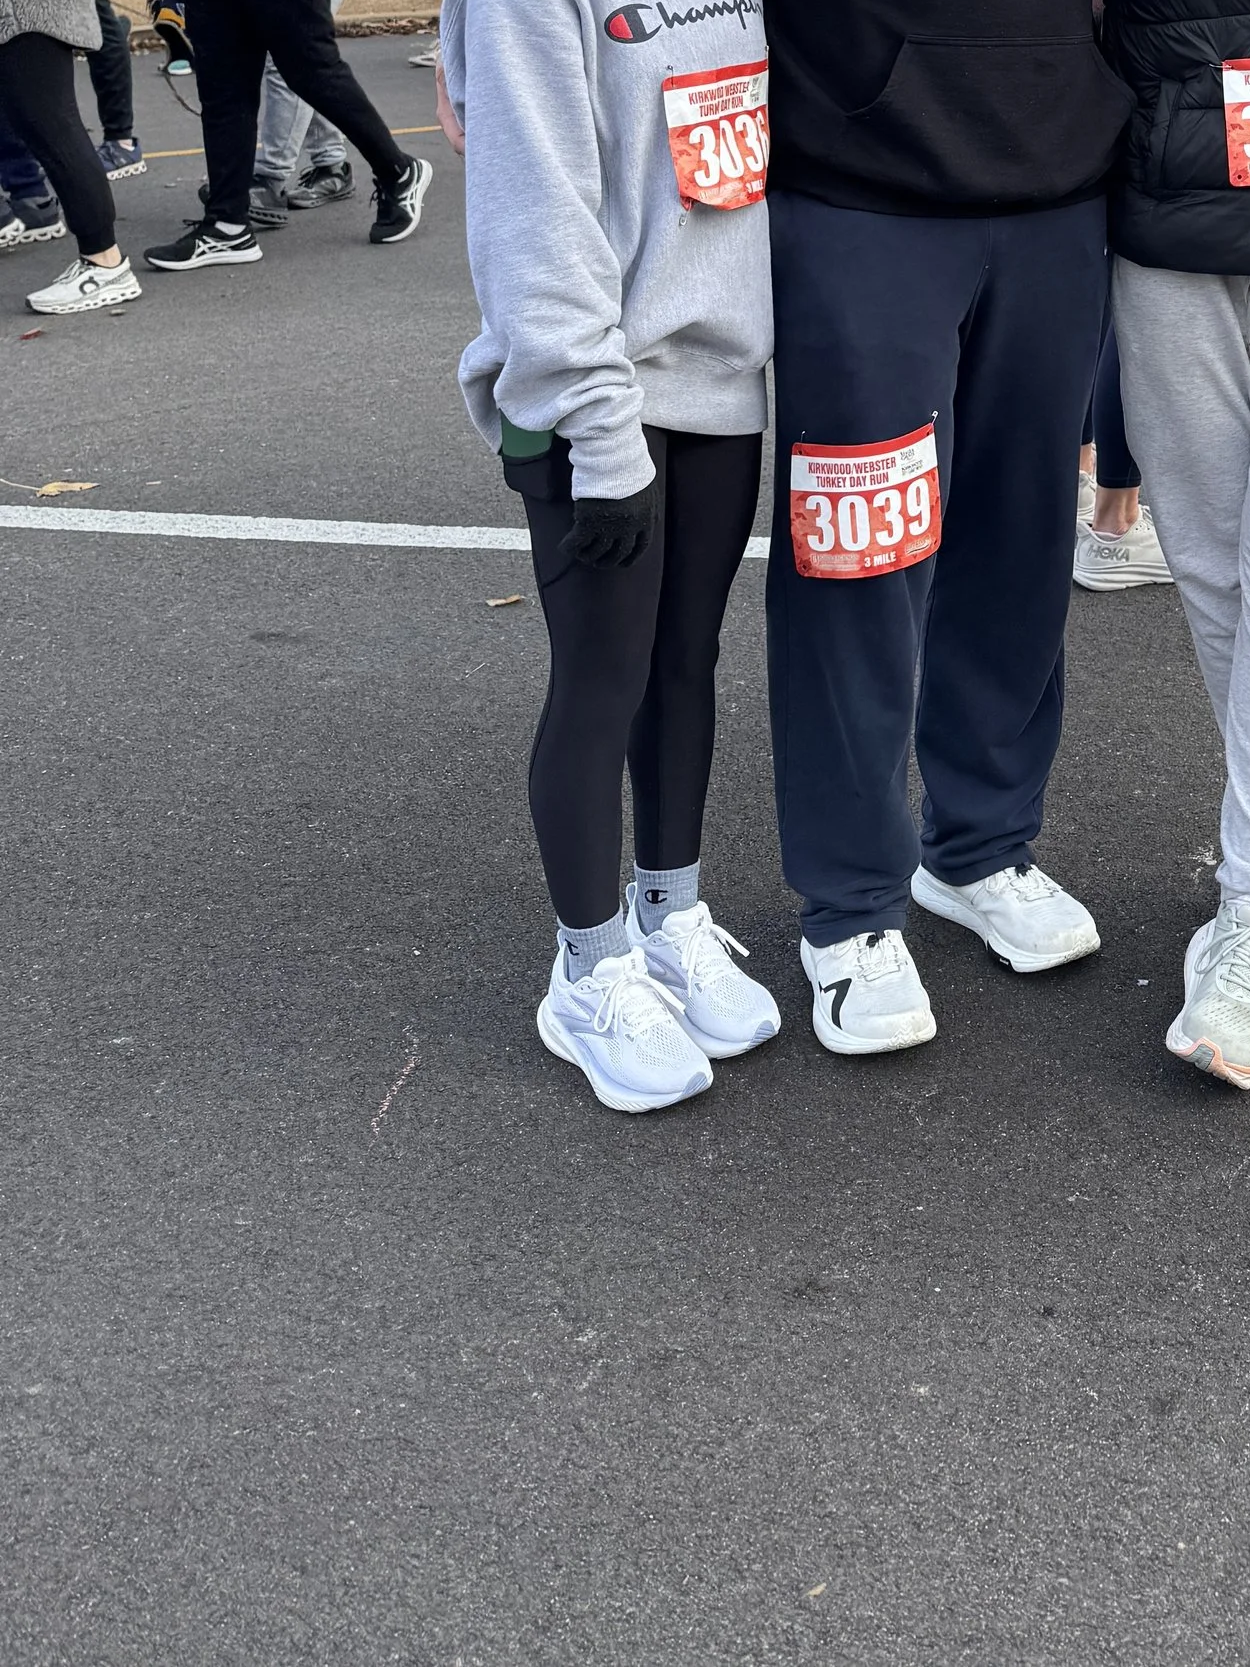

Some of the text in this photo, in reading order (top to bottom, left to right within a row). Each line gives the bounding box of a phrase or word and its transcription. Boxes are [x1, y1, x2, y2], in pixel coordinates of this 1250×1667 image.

[689, 110, 770, 188] 3036
[808, 456, 897, 475] KIRKWOOD/WEBSTER
[816, 472, 889, 488] TURKEY DAY RUN
[805, 477, 932, 552] 3039
[864, 556, 871, 568] 3
[873, 551, 897, 567] MILE
[1087, 544, 1130, 562] HOKA
